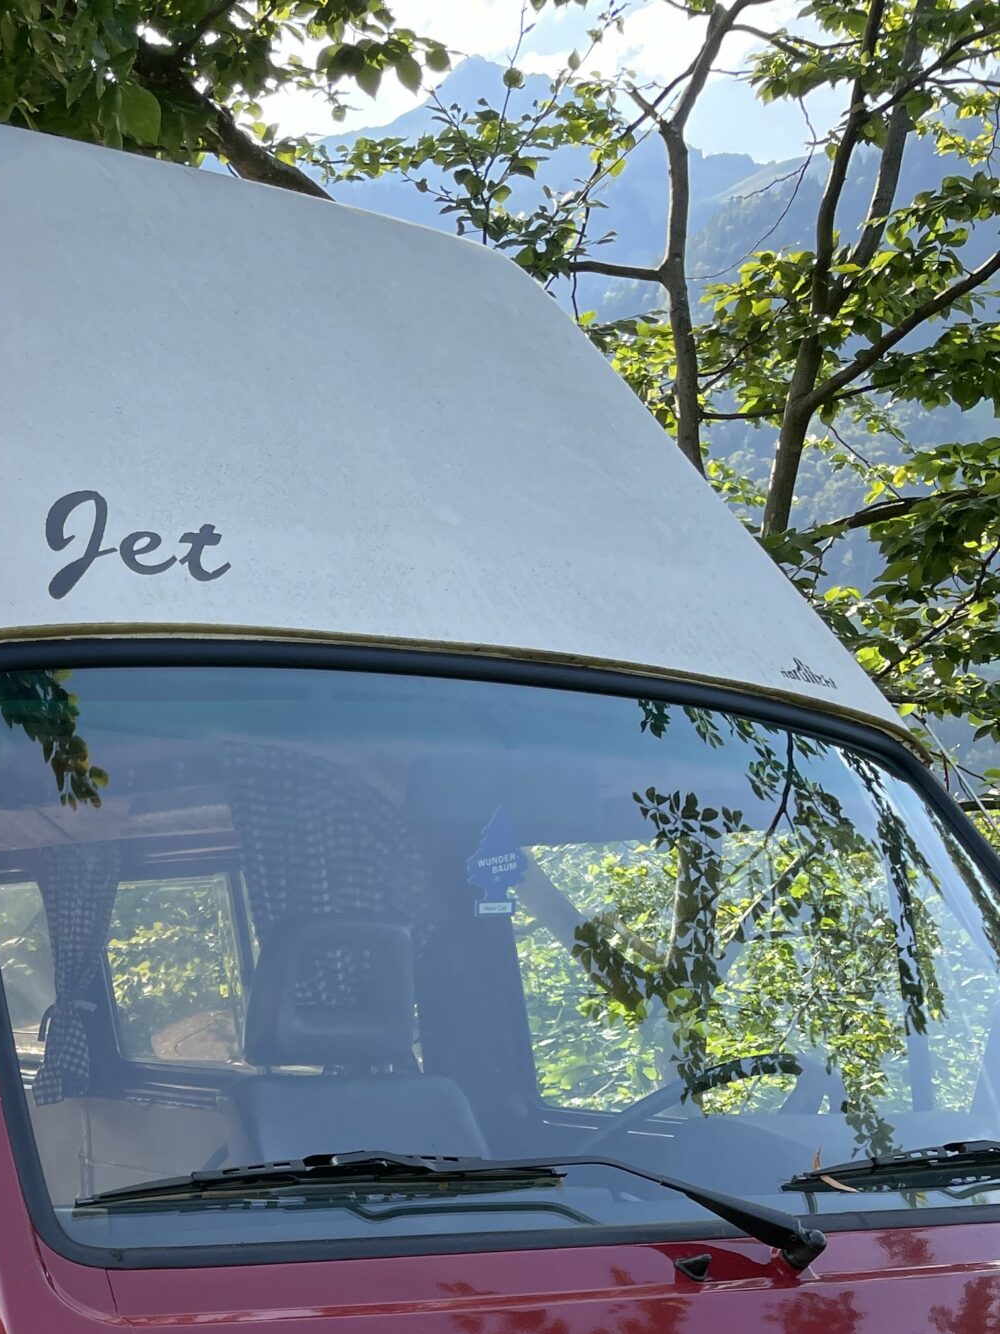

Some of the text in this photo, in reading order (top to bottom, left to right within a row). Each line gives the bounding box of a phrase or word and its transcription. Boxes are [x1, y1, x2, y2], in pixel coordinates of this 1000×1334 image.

[45, 489, 232, 600] Jet
[477, 852, 520, 868] WUNDER-
[492, 861, 518, 875] BAUM
